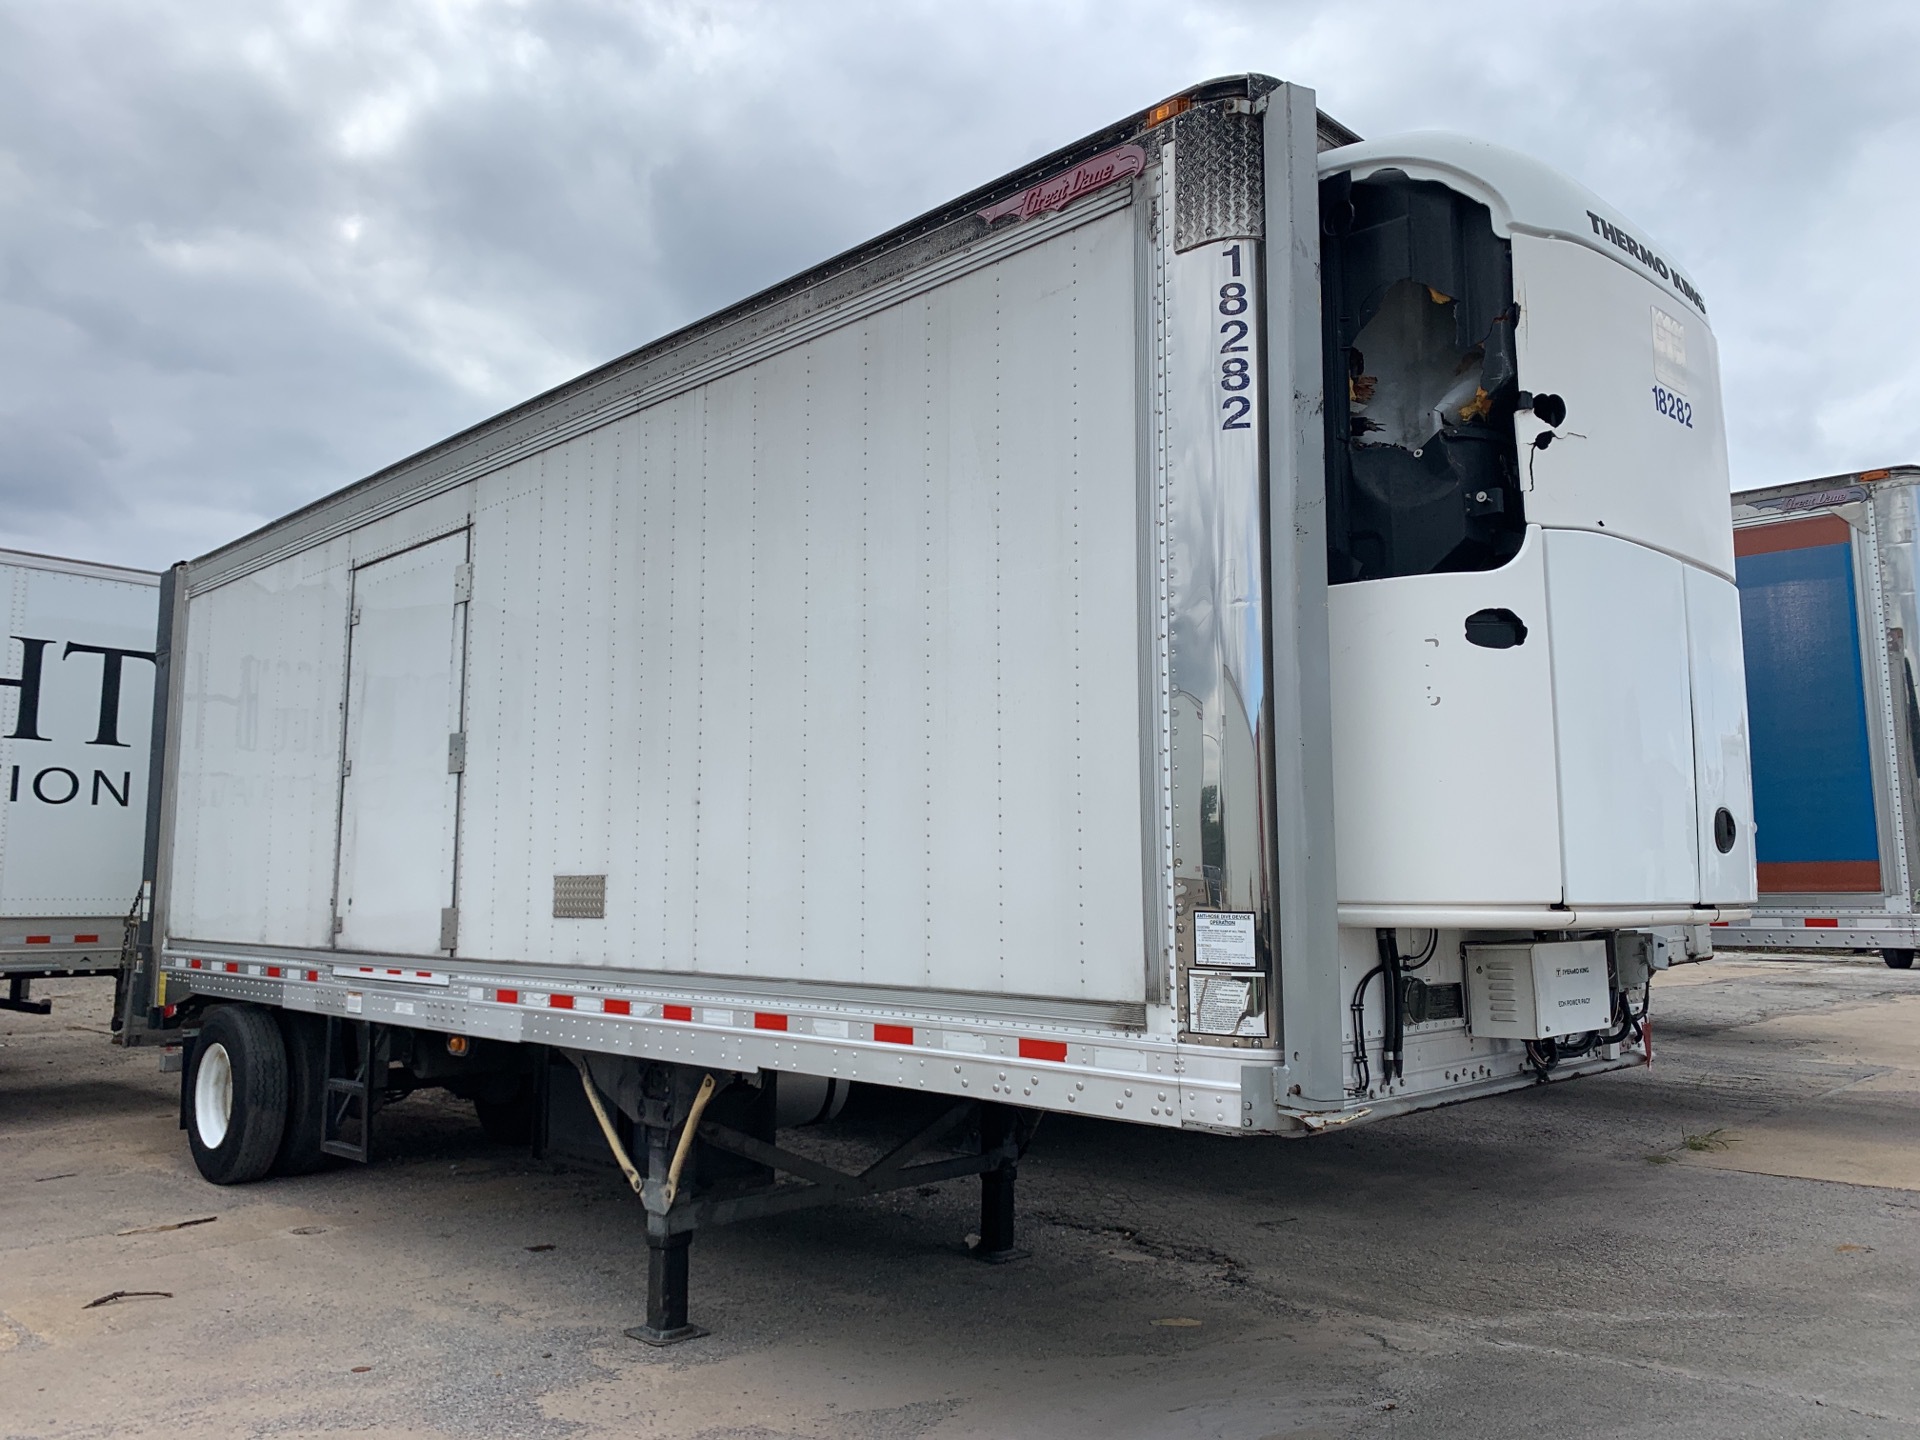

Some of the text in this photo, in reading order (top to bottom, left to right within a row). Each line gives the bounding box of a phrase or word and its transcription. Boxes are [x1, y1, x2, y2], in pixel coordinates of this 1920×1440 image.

[1025, 163, 1114, 216] Great Dane
[1586, 209, 1707, 315] THERMO KING
[1218, 244, 1251, 430] 18282
[1652, 385, 1693, 429] 18282
